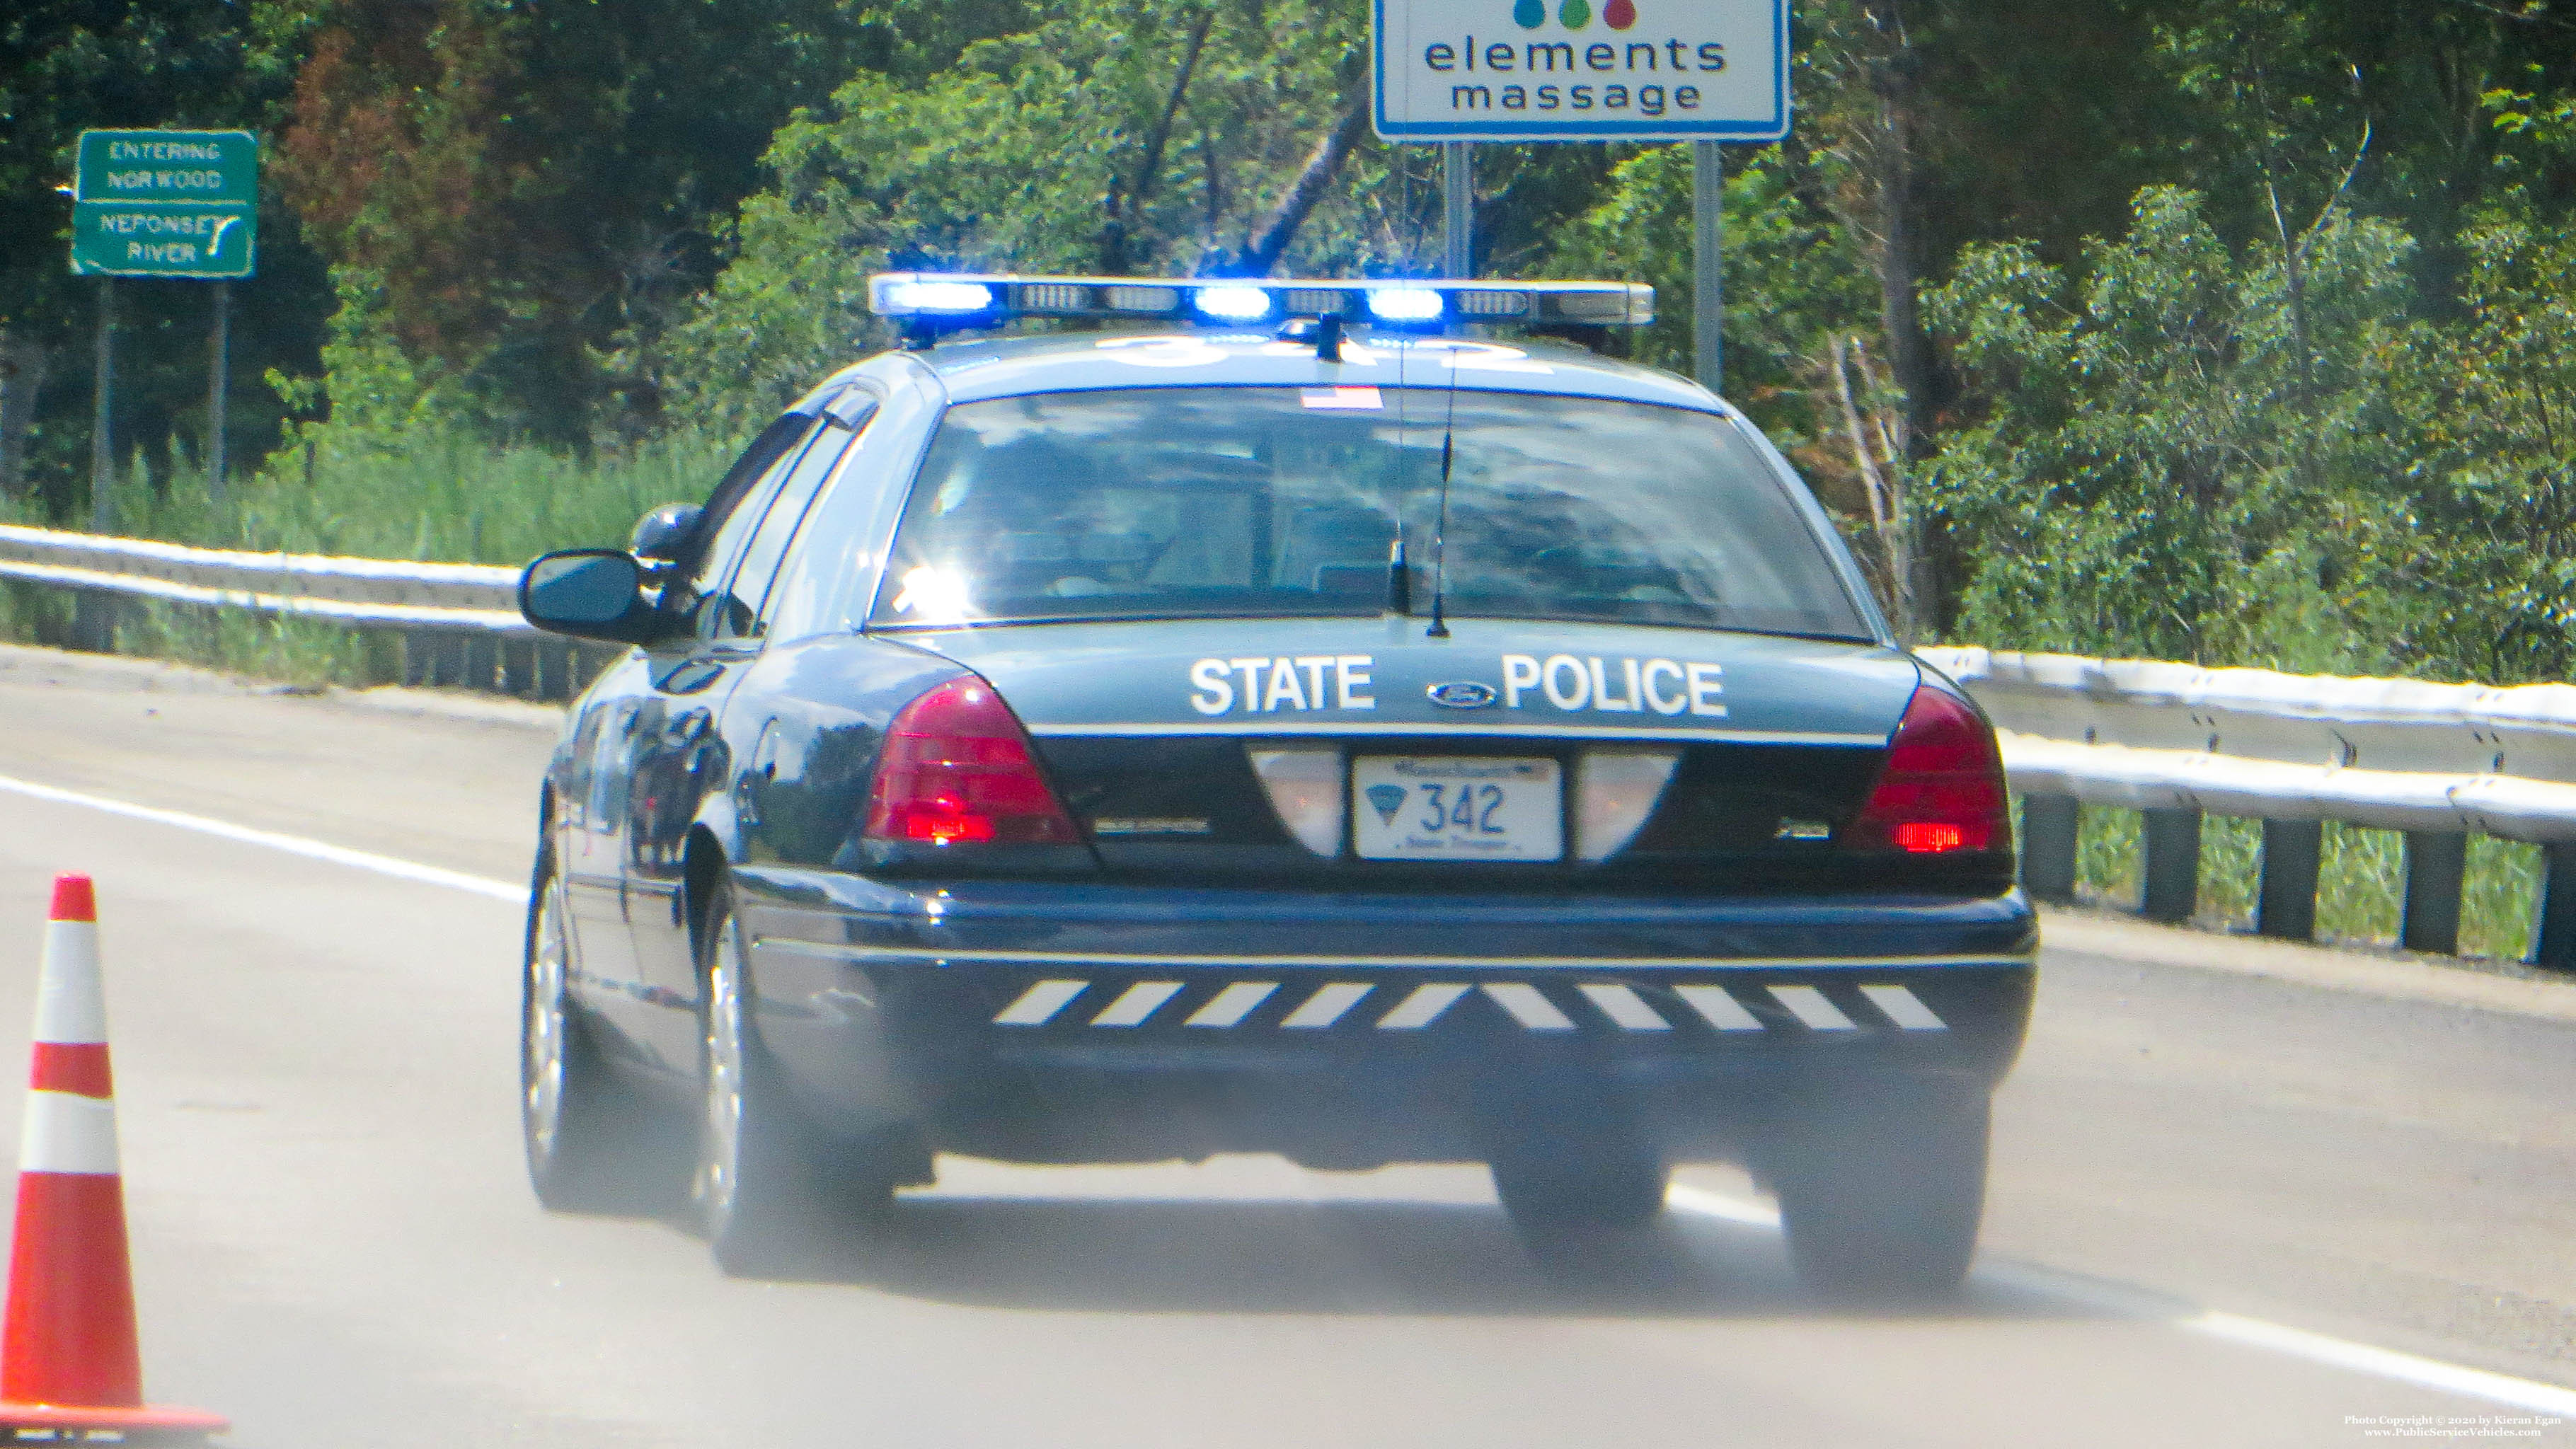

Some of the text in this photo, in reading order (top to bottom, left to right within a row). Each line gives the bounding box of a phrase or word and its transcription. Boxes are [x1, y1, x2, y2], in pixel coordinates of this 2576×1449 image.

[1425, 35, 1727, 71] elements
[1451, 83, 1701, 116] massage
[108, 142, 221, 160] ENTERING
[107, 171, 222, 189] NORWOOD
[127, 243, 197, 262] RIVER
[1190, 654, 1376, 716] STATE
[1502, 654, 1729, 717] POLICE
[1420, 783, 1506, 833] 342
